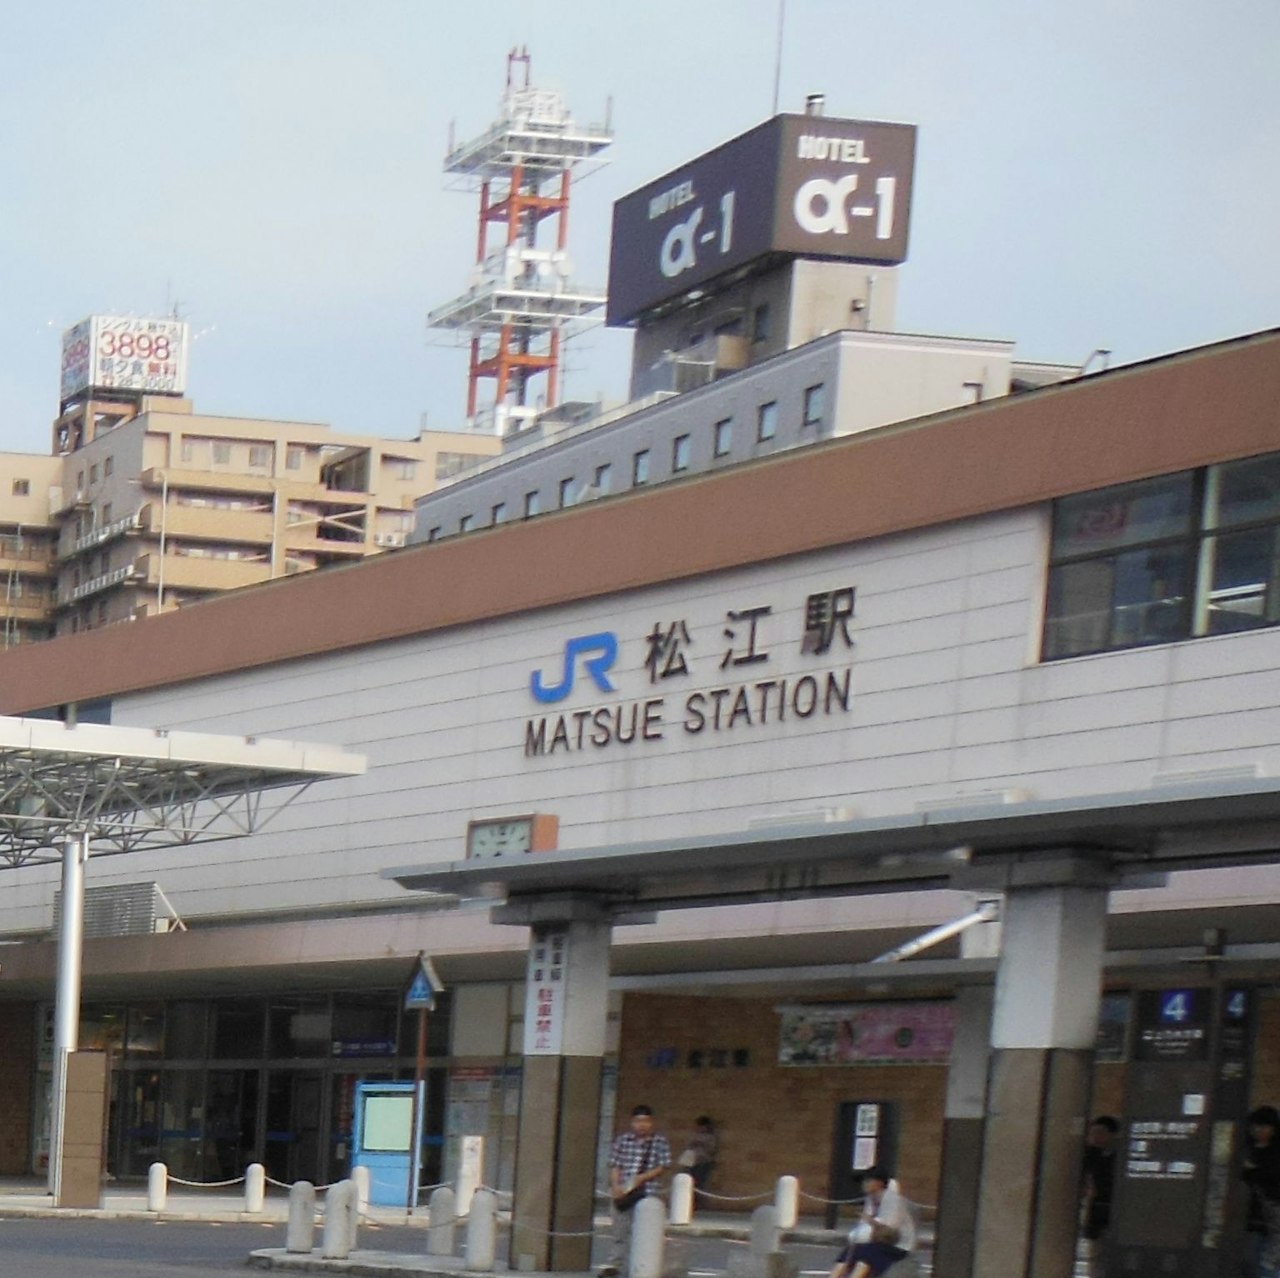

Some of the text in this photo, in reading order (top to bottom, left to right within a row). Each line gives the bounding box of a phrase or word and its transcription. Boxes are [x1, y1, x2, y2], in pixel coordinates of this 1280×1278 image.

[798, 135, 870, 164] HOTEL
[100, 331, 169, 361] 3898
[645, 586, 856, 684] 松江駅
[531, 631, 618, 703] JR
[524, 668, 852, 757] MATSUE STATION
[1163, 993, 1188, 1021] 4
[1229, 993, 1245, 1018] 4
